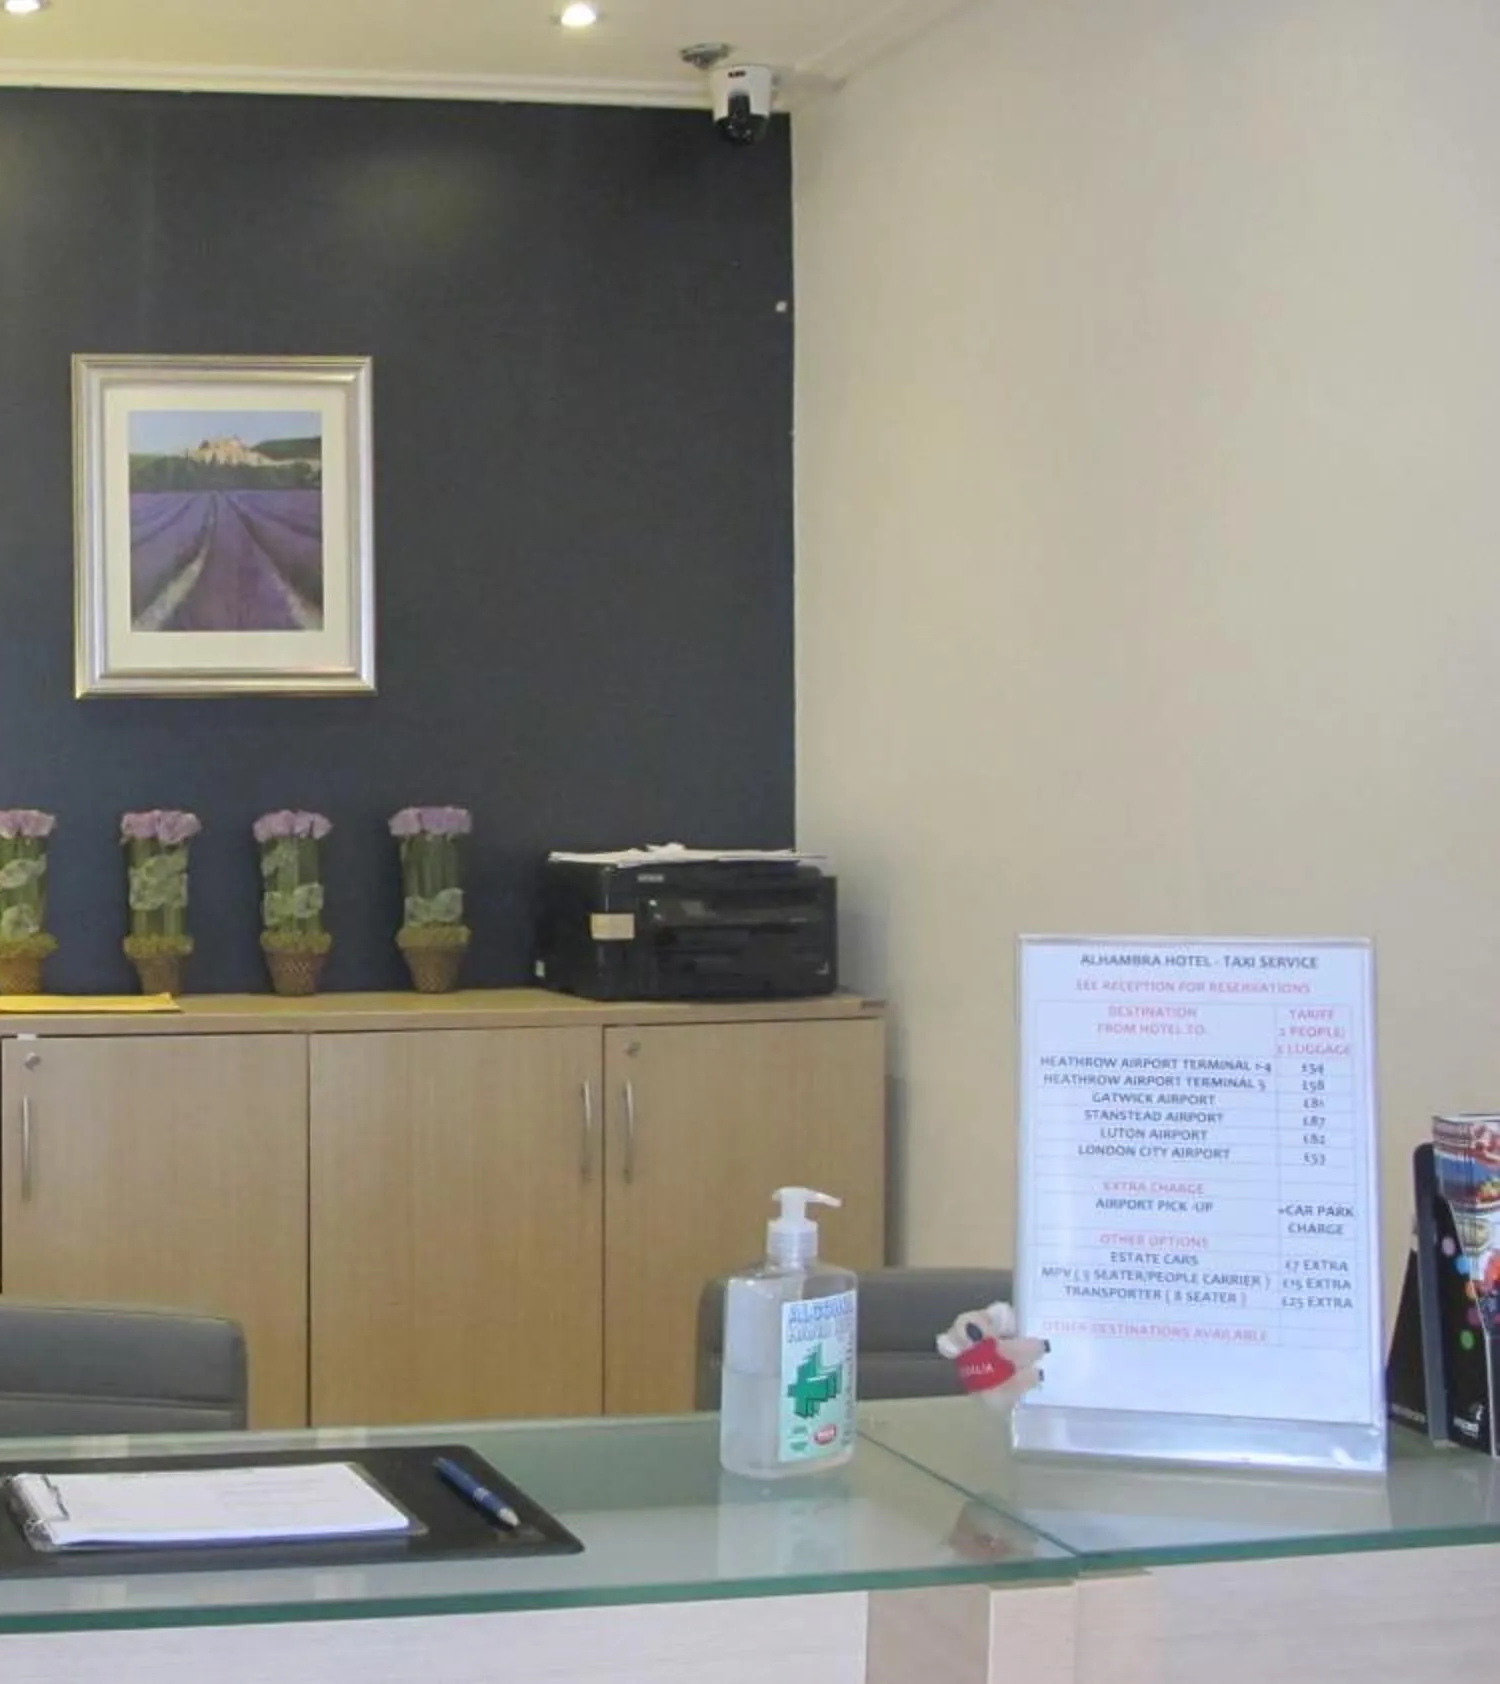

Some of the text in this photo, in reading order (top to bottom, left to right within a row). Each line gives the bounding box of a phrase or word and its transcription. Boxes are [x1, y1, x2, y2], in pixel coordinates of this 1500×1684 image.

[1080, 954, 1161, 967] ALHAMBRA
[1165, 955, 1211, 968] HOTEL
[1224, 955, 1256, 968] TAXI
[1260, 956, 1318, 969] SERVICE
[1102, 980, 1175, 992] RECEPTION
[1178, 981, 1205, 992] FOR
[1209, 981, 1311, 994] RESERVATIONS
[1108, 1006, 1197, 1018] DESTINATION
[1289, 1009, 1333, 1020] TARIFF
[1098, 1023, 1136, 1034] FROM
[1140, 1023, 1182, 1035] HOTEL
[1040, 1056, 1117, 1068] HEATHROW
[1121, 1057, 1178, 1069] AIRPORT
[1183, 1059, 1251, 1071] TERMINAL
[1043, 1073, 1120, 1085] HEATHROW
[1124, 1075, 1181, 1087] AIRPORT
[1186, 1076, 1254, 1089] TERMINAL
[1092, 1092, 1216, 1105] GATWICK AIRPORT
[1084, 1110, 1223, 1123] STANSTEAD AIRPORT
[1100, 1127, 1208, 1141] LUTON AIRPORT
[1077, 1145, 1230, 1160] LONDON CITY AIRPORT
[1103, 1181, 1204, 1195] EXTRA CHARGE
[1096, 1198, 1154, 1210] AIRPORT
[1158, 1200, 1188, 1212] PICK
[1317, 1205, 1354, 1217] PARK
[1288, 1222, 1344, 1235] CHARGE
[1100, 1234, 1209, 1248] OTHER OPTIONS
[1110, 1252, 1199, 1265] ESTATE CARS
[1303, 1260, 1348, 1272] EXTRA
[1203, 1273, 1262, 1287] CARRIER
[1306, 1278, 1351, 1291] EXTRA
[1064, 1285, 1162, 1301] TRANSPORTER
[1186, 1291, 1237, 1304] SEATER
[1307, 1297, 1353, 1309] EXTRA
[1092, 1323, 1191, 1338] DESTINATIONS
[1193, 1327, 1267, 1341] AVAILABLE
